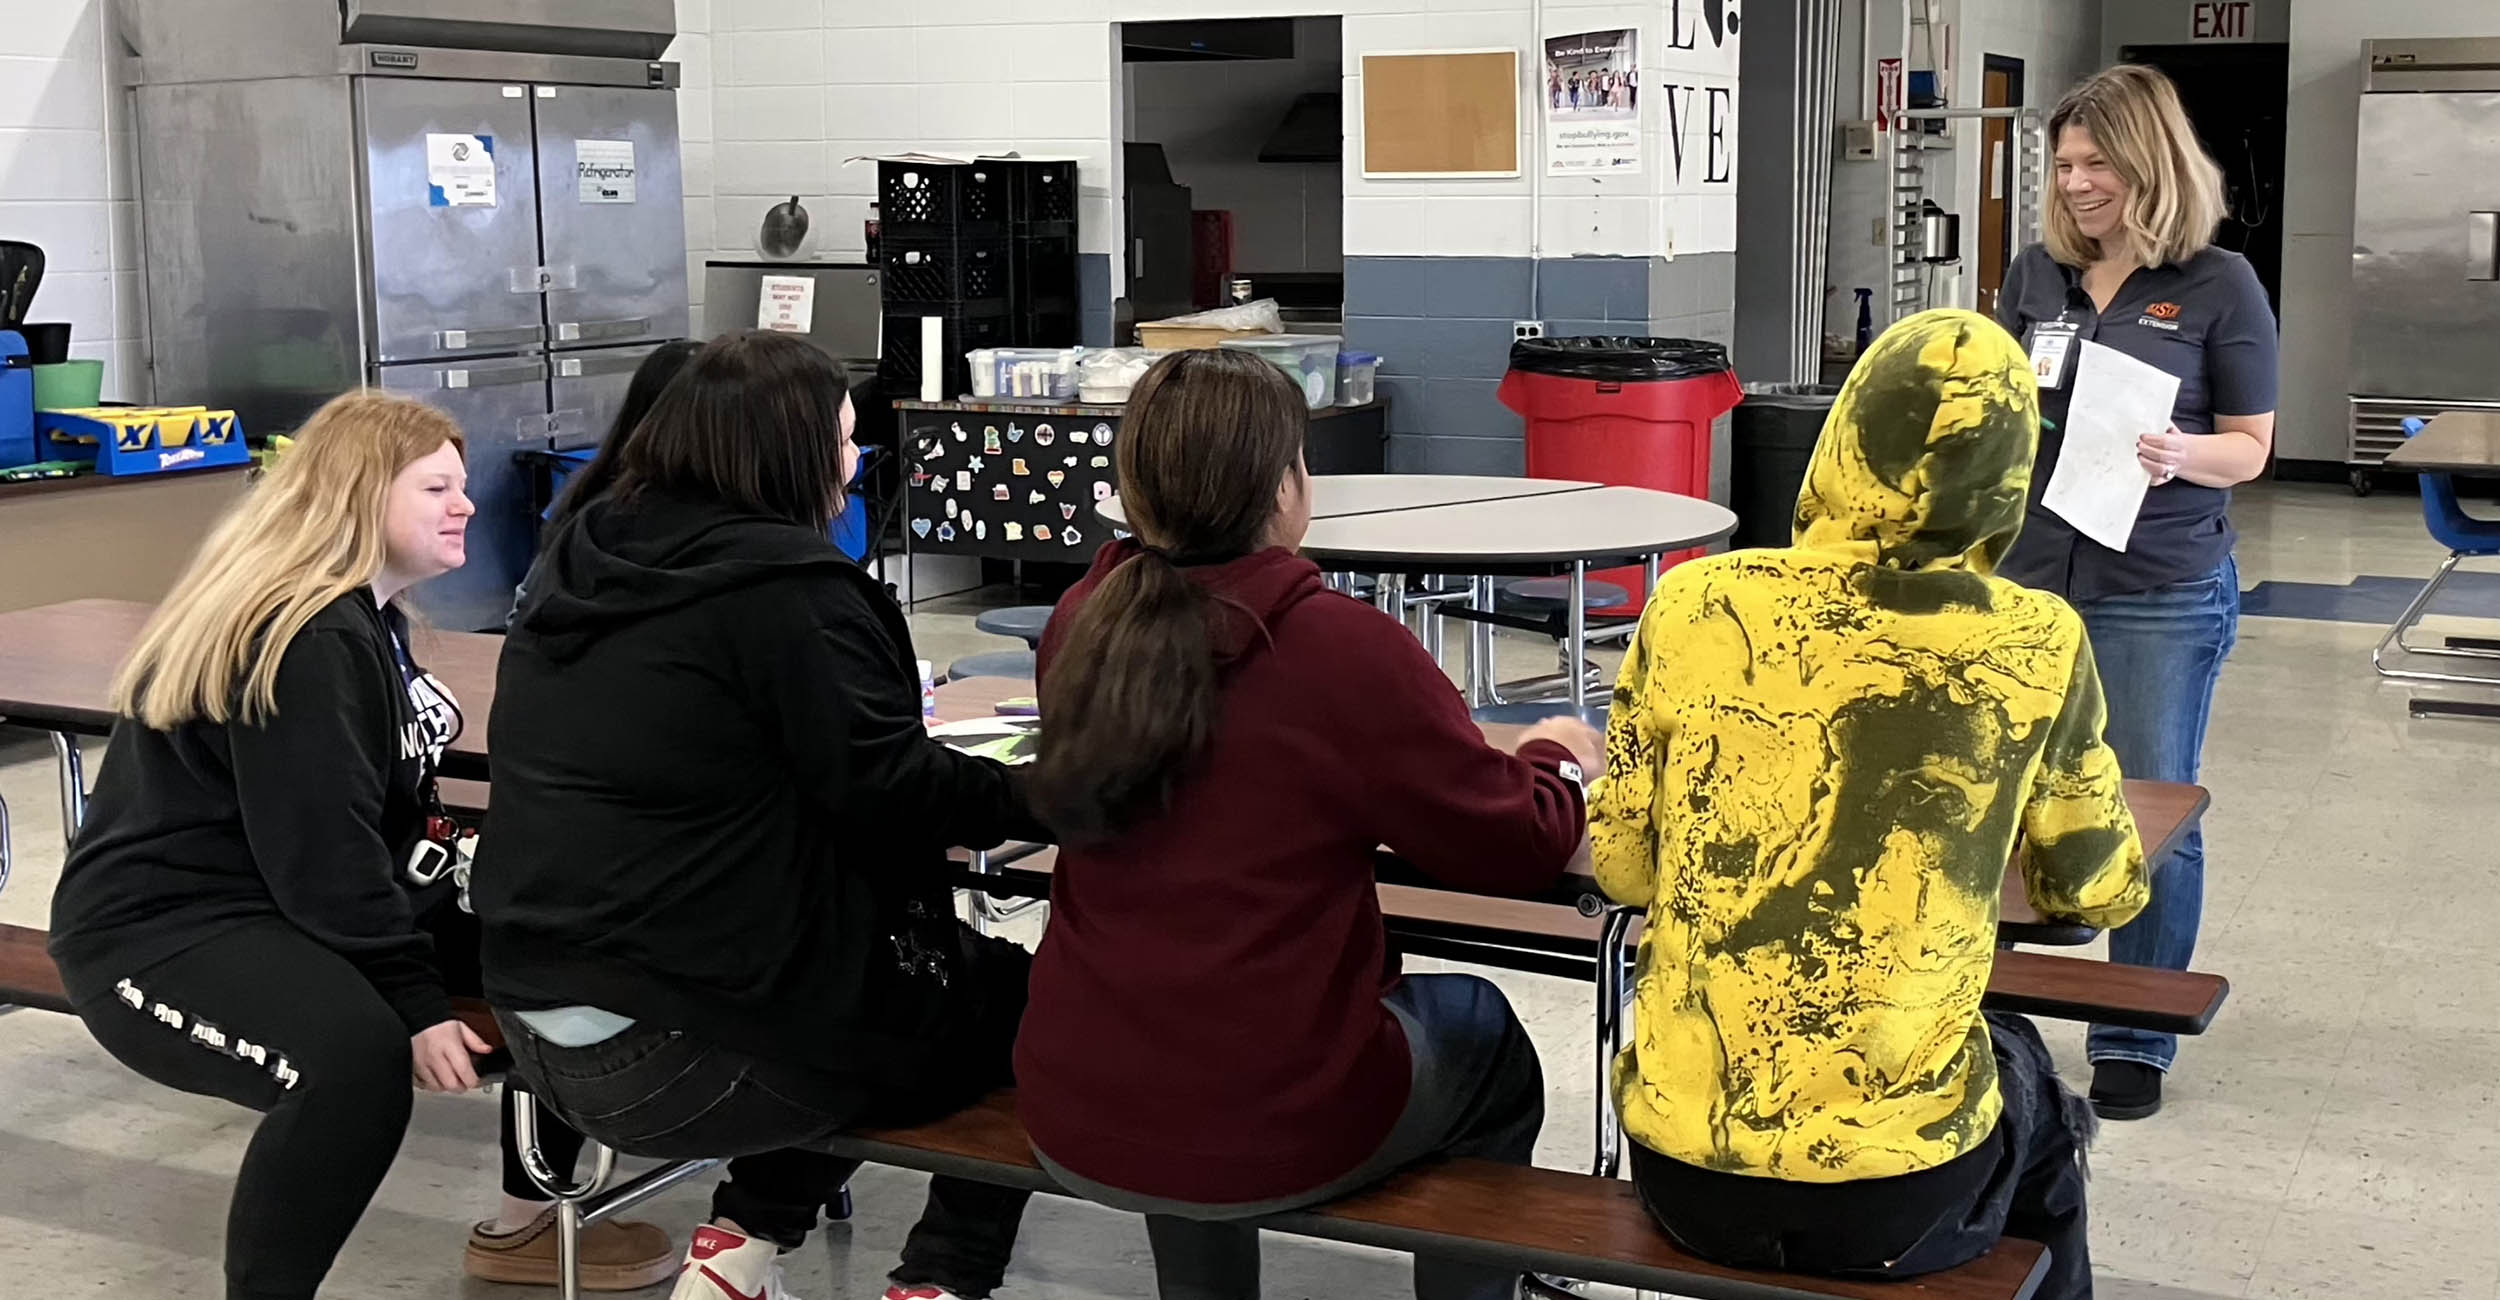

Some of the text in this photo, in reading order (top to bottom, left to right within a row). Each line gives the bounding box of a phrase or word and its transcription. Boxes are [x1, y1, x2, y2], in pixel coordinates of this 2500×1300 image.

[2193, 2, 2250, 38] EXIT
[1567, 47, 1584, 55] Kind
[1663, 84, 1730, 186] VE
[578, 161, 635, 181] Refrigerator
